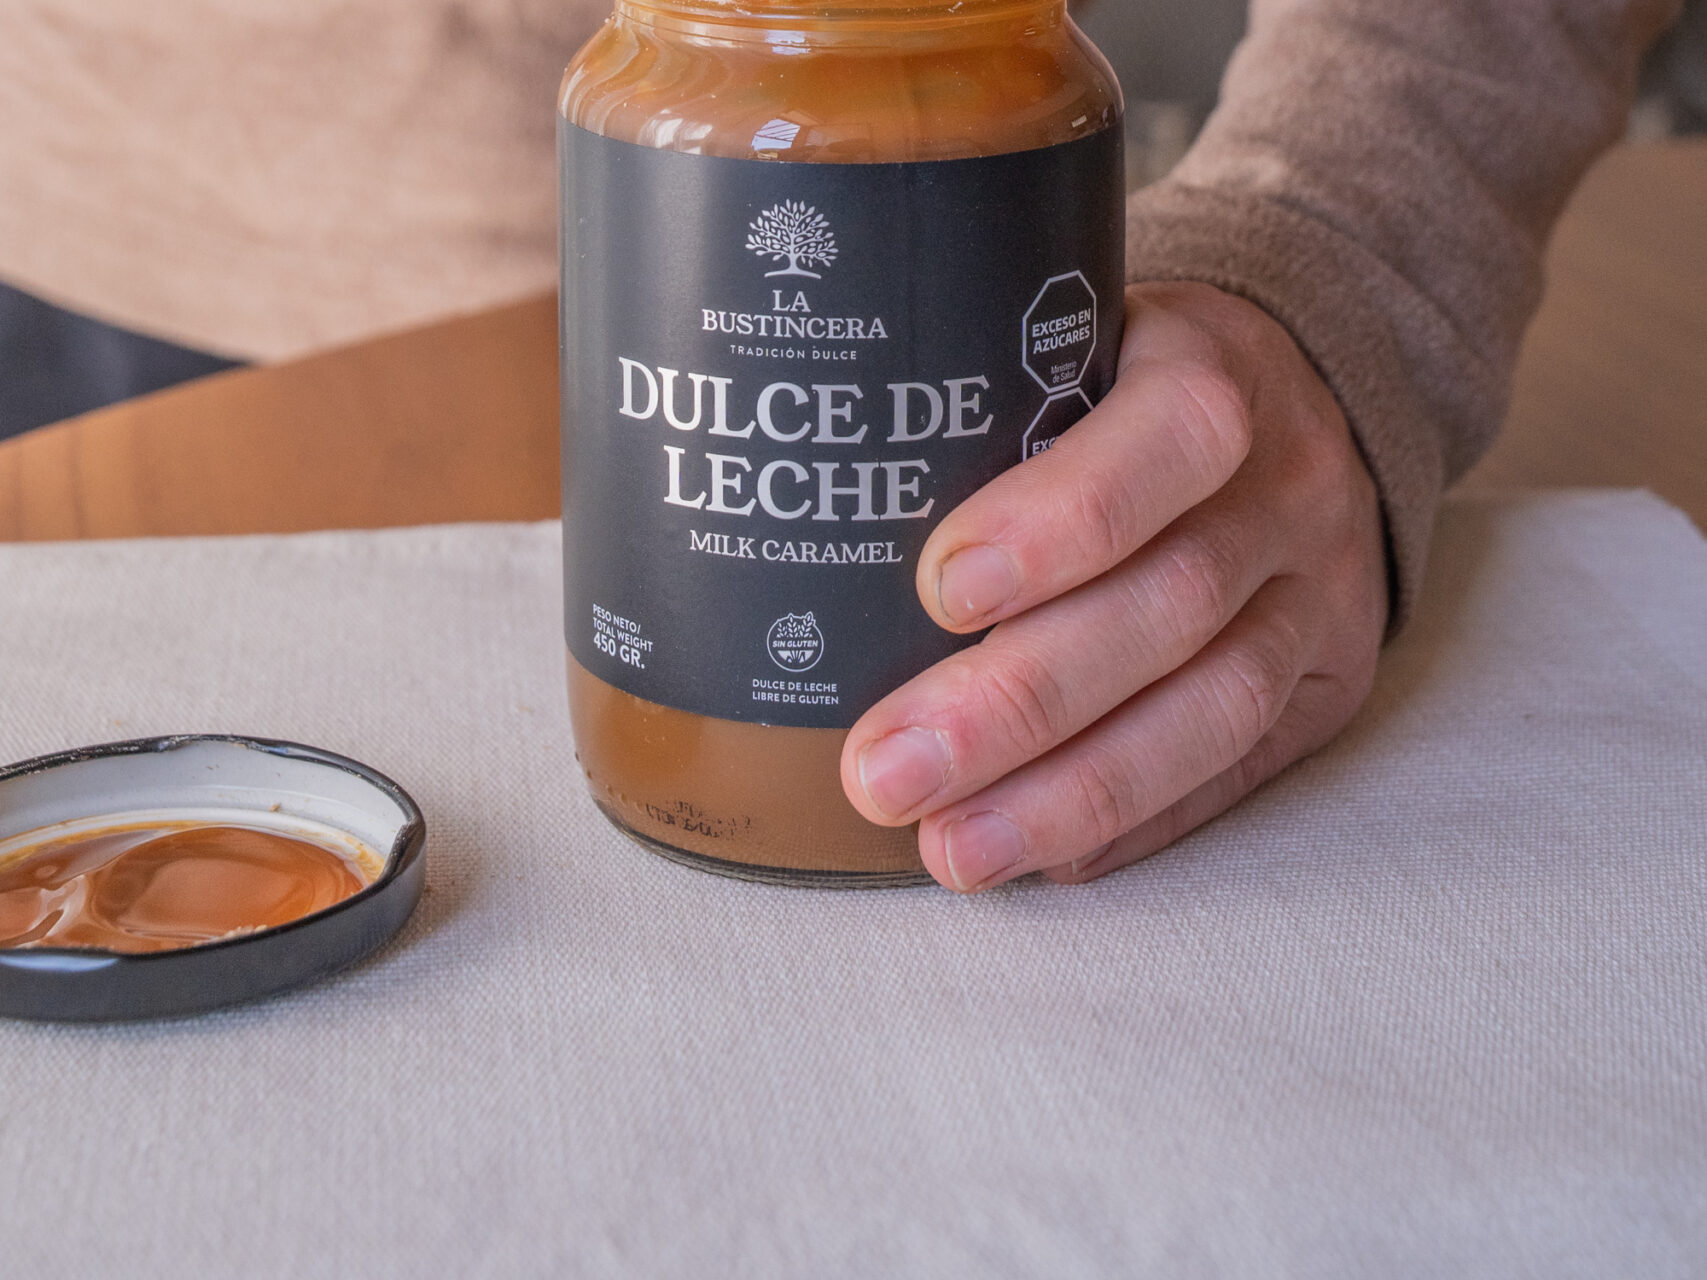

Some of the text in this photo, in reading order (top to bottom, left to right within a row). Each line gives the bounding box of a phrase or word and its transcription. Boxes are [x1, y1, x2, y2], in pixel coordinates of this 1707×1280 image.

[772, 290, 811, 313] LA
[702, 309, 888, 340] BUSTINCERA
[1032, 308, 1091, 338] EXCESO EN
[730, 344, 858, 360] TRADICIÓN DULCE
[1033, 325, 1090, 354] AZÚCARES
[1053, 375, 1060, 384] de
[618, 357, 994, 445] DULCE DE
[1032, 435, 1060, 456] EXC
[663, 445, 935, 521] LECHE
[689, 529, 903, 565] MILK CARAMEL
[593, 603, 641, 634] PESO NETO/
[593, 617, 653, 652] TOTAL WEIGHT
[772, 640, 819, 648] SIN GLUTEN
[593, 631, 645, 669] 450 GR.
[752, 679, 837, 693] DULCE DE LECHE
[752, 691, 839, 705] LIBRE DE GLUTEN
